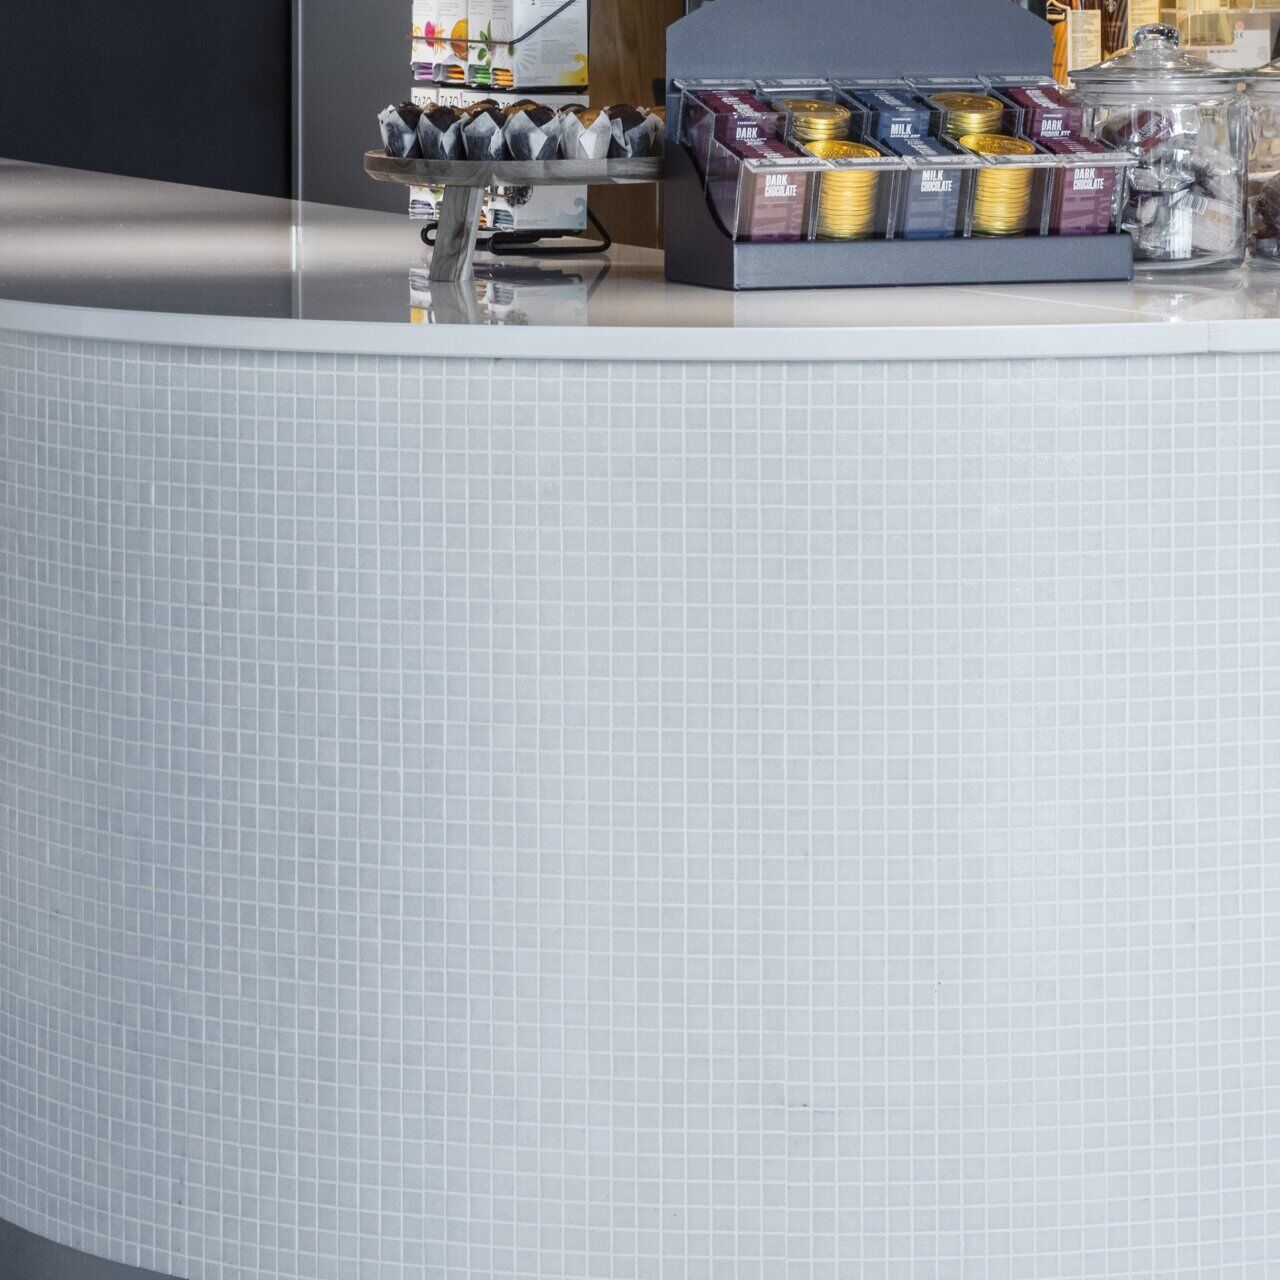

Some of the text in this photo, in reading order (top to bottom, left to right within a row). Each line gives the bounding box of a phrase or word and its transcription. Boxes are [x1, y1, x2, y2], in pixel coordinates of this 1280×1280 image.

[890, 123, 912, 135] MILK
[1041, 119, 1063, 131] DARK
[735, 127, 758, 138] DARK
[922, 169, 944, 181] MILK
[1074, 168, 1095, 179] DARK
[765, 174, 788, 186] DARK
[920, 180, 953, 192] CHOCOLATE
[1073, 178, 1105, 190] CHOCOLATE
[764, 185, 797, 197] CHOCOLATE
